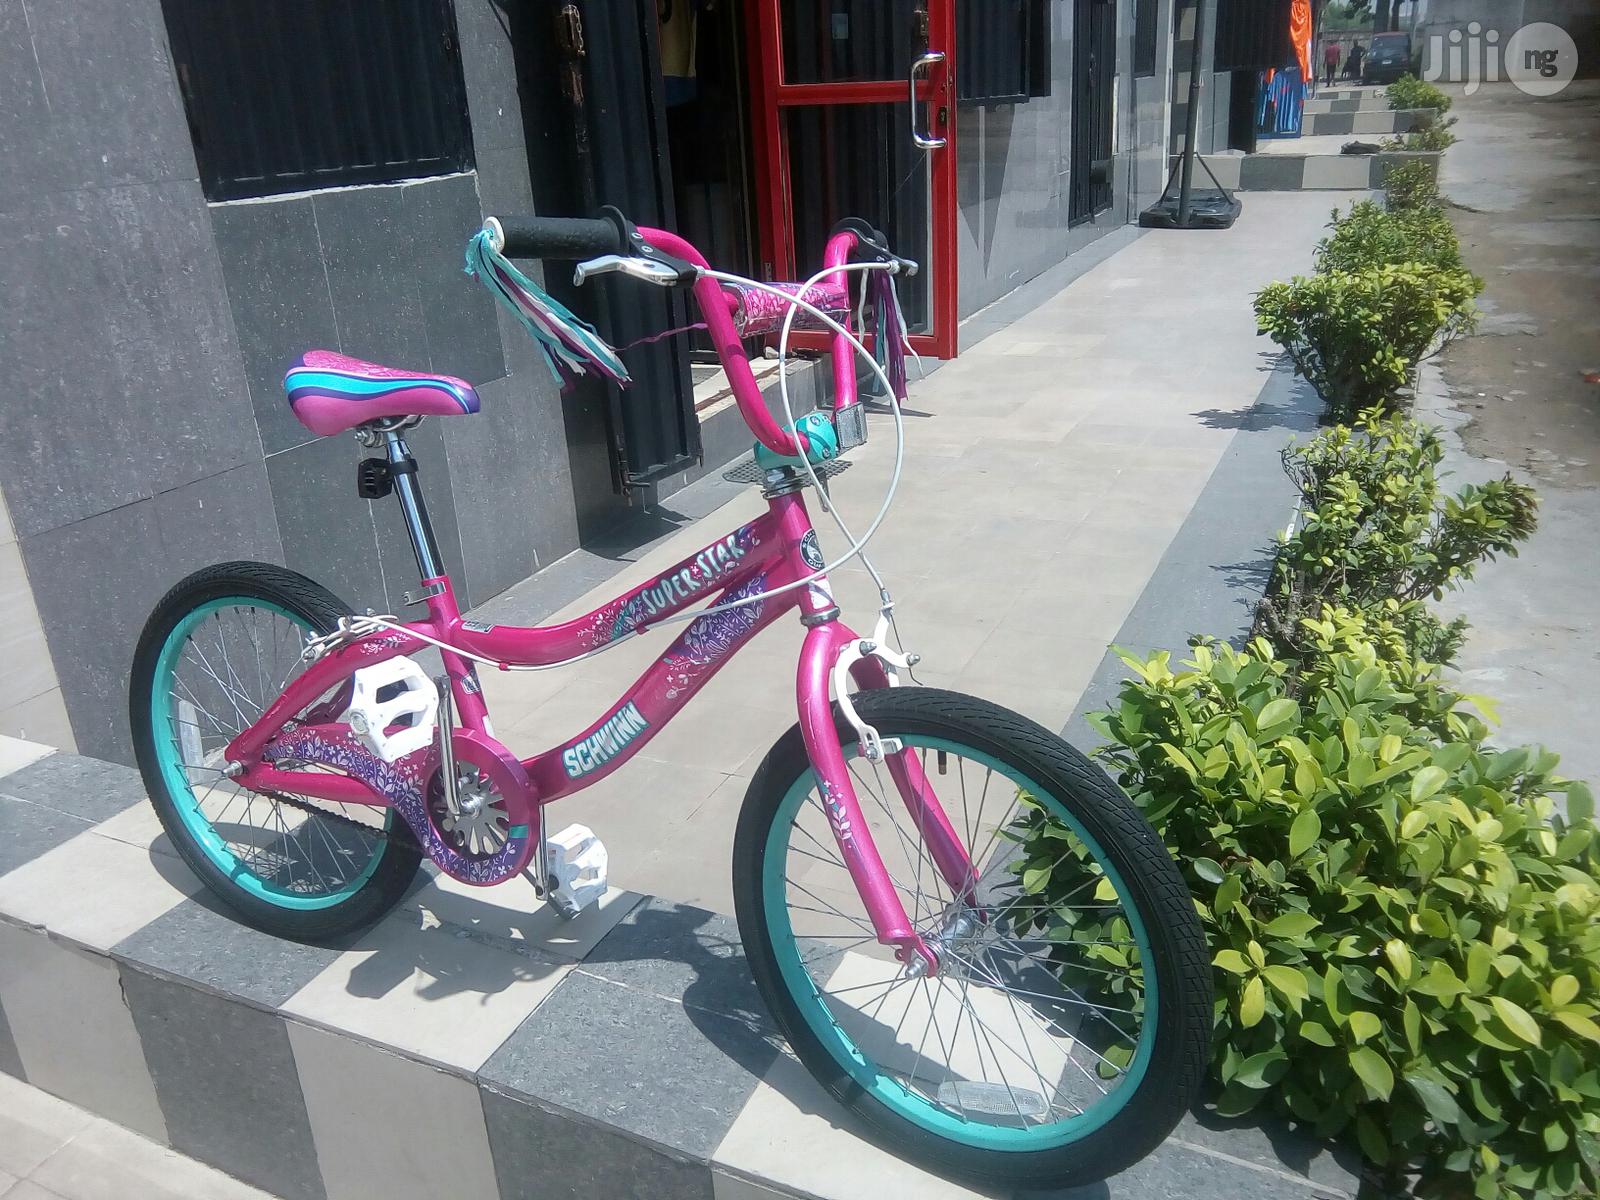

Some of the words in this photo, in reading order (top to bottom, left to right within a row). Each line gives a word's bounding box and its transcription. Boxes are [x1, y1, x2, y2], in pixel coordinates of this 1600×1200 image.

[641, 568, 700, 615] SUPER
[697, 535, 745, 578] STAR
[563, 700, 648, 777] SCHWINN
